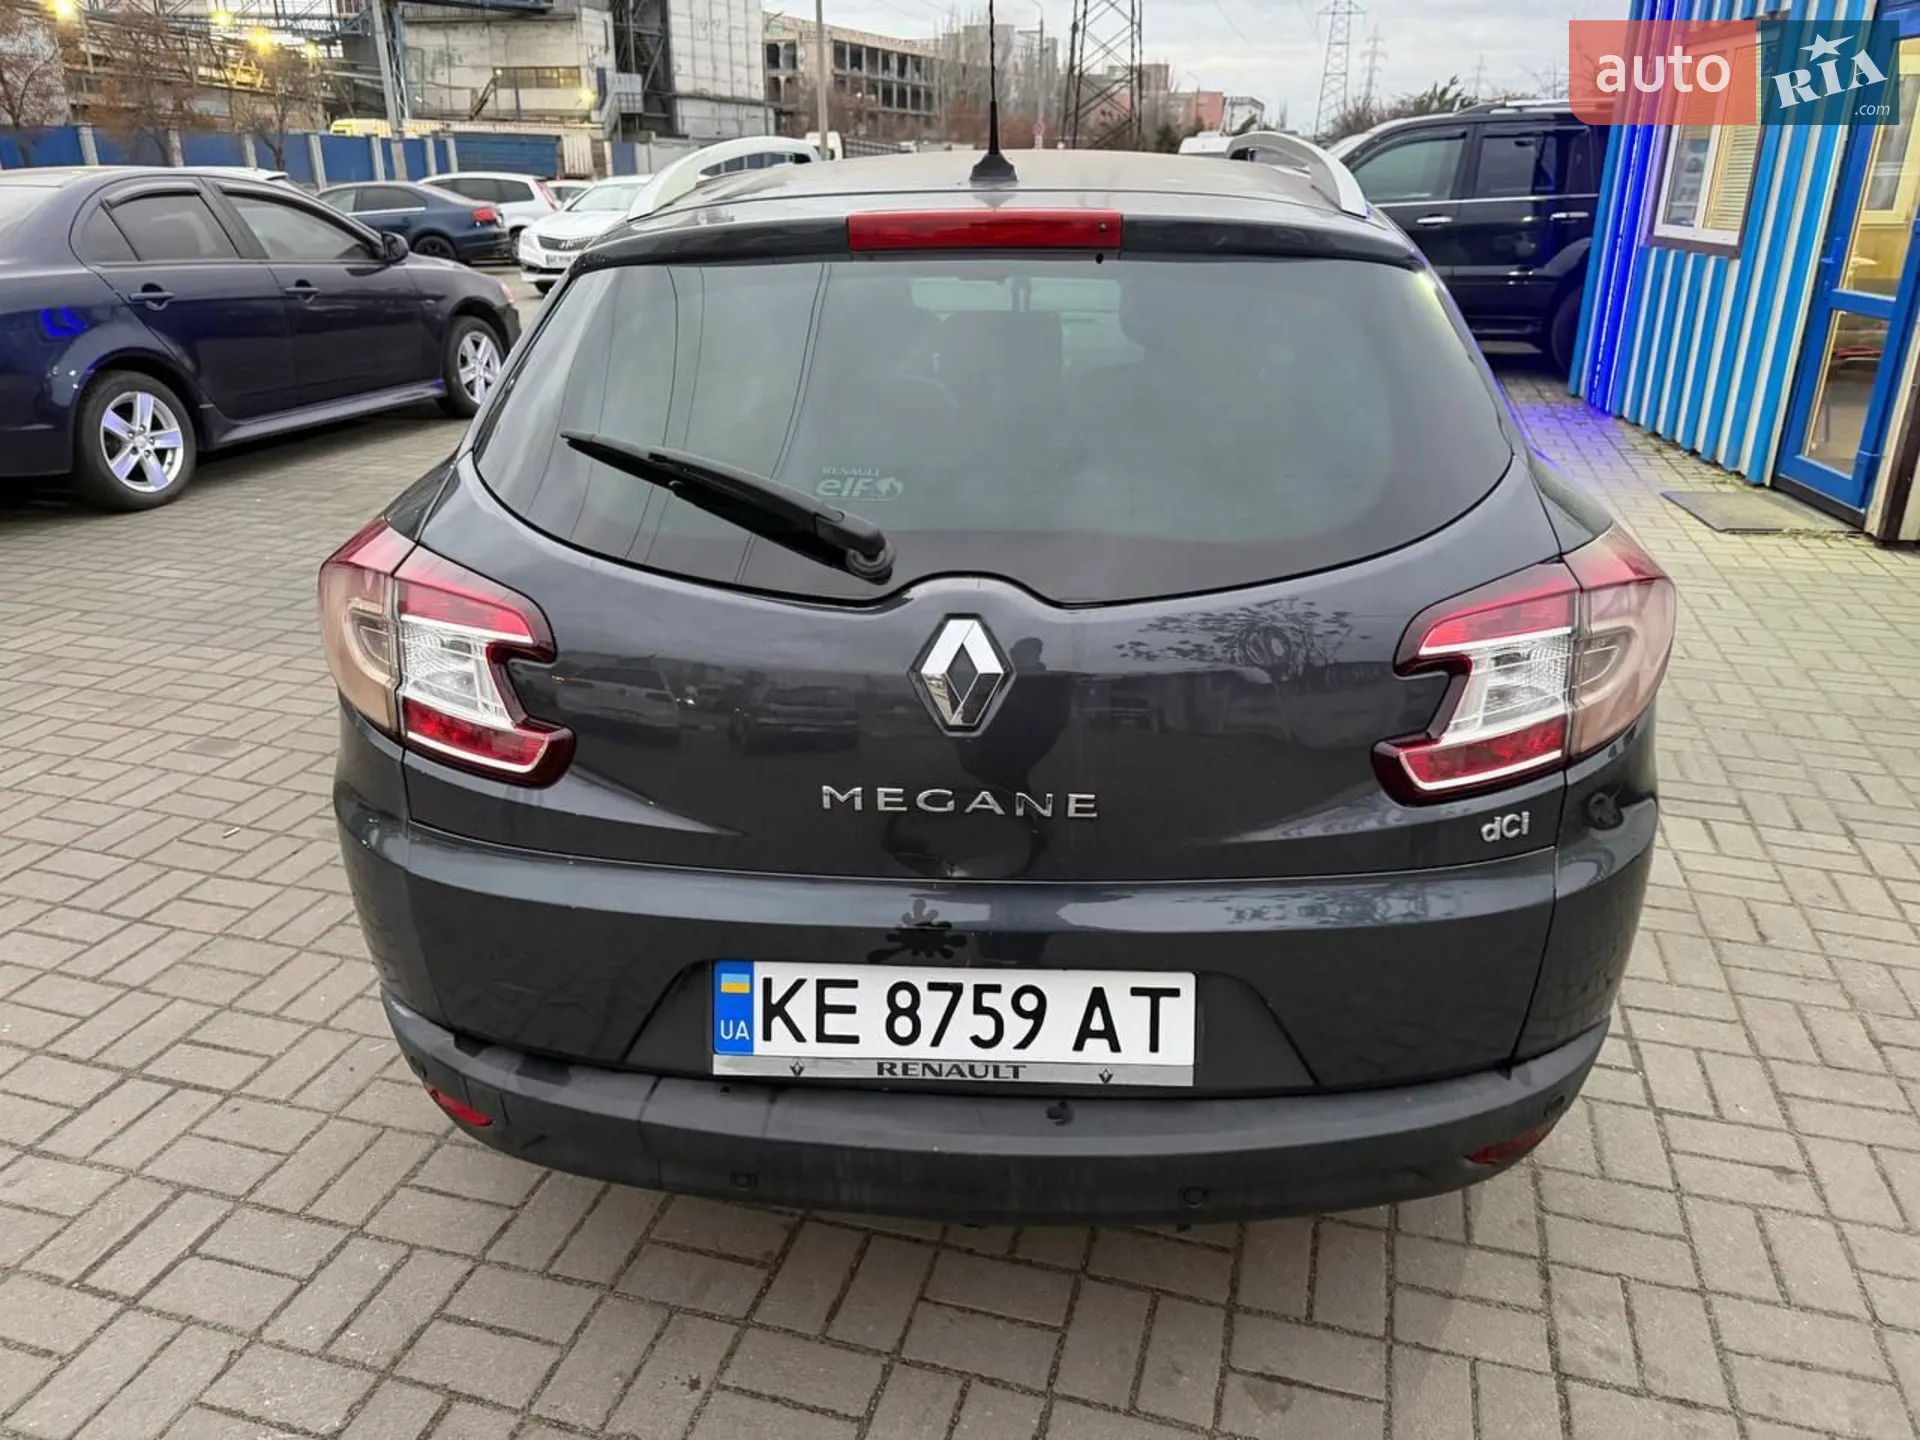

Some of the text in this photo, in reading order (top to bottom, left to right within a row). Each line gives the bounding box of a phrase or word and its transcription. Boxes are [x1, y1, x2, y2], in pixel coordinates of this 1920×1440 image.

[821, 785, 1098, 818] MEGANE
[1481, 811, 1530, 842] dCi
[719, 1019, 750, 1042] UA
[761, 977, 1181, 1053] KE 8759 AT
[876, 1061, 1027, 1080] RENAULT
